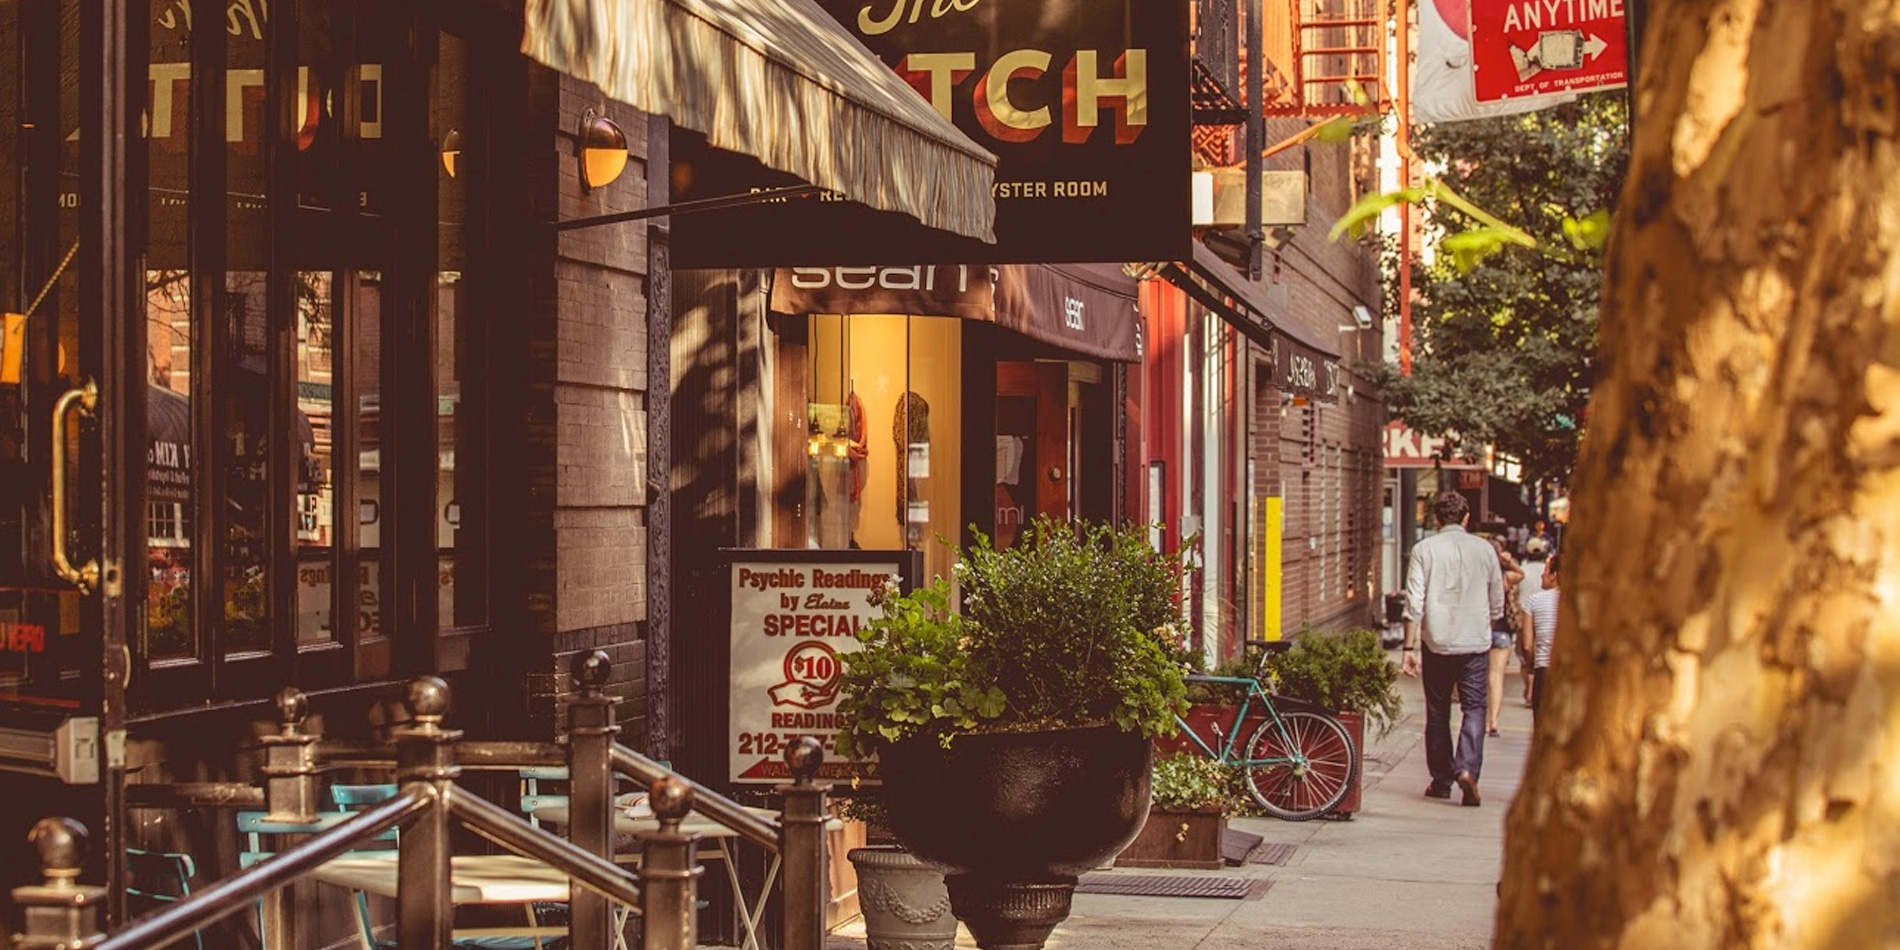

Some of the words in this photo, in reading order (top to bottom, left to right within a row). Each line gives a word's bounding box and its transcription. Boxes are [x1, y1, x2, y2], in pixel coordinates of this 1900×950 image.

[1503, 0, 1625, 33] ANYTIME
[1514, 83, 1536, 93] DEPT
[1538, 80, 1550, 90] OF
[1554, 71, 1624, 87] TRANSPORTATION
[893, 49, 1148, 145] TCH
[990, 182, 1047, 198] YSTER
[1053, 181, 1108, 197] ROOM
[739, 567, 805, 592] Psychic
[780, 593, 800, 611] by
[804, 593, 851, 610] Elaine
[794, 656, 832, 680] $10
